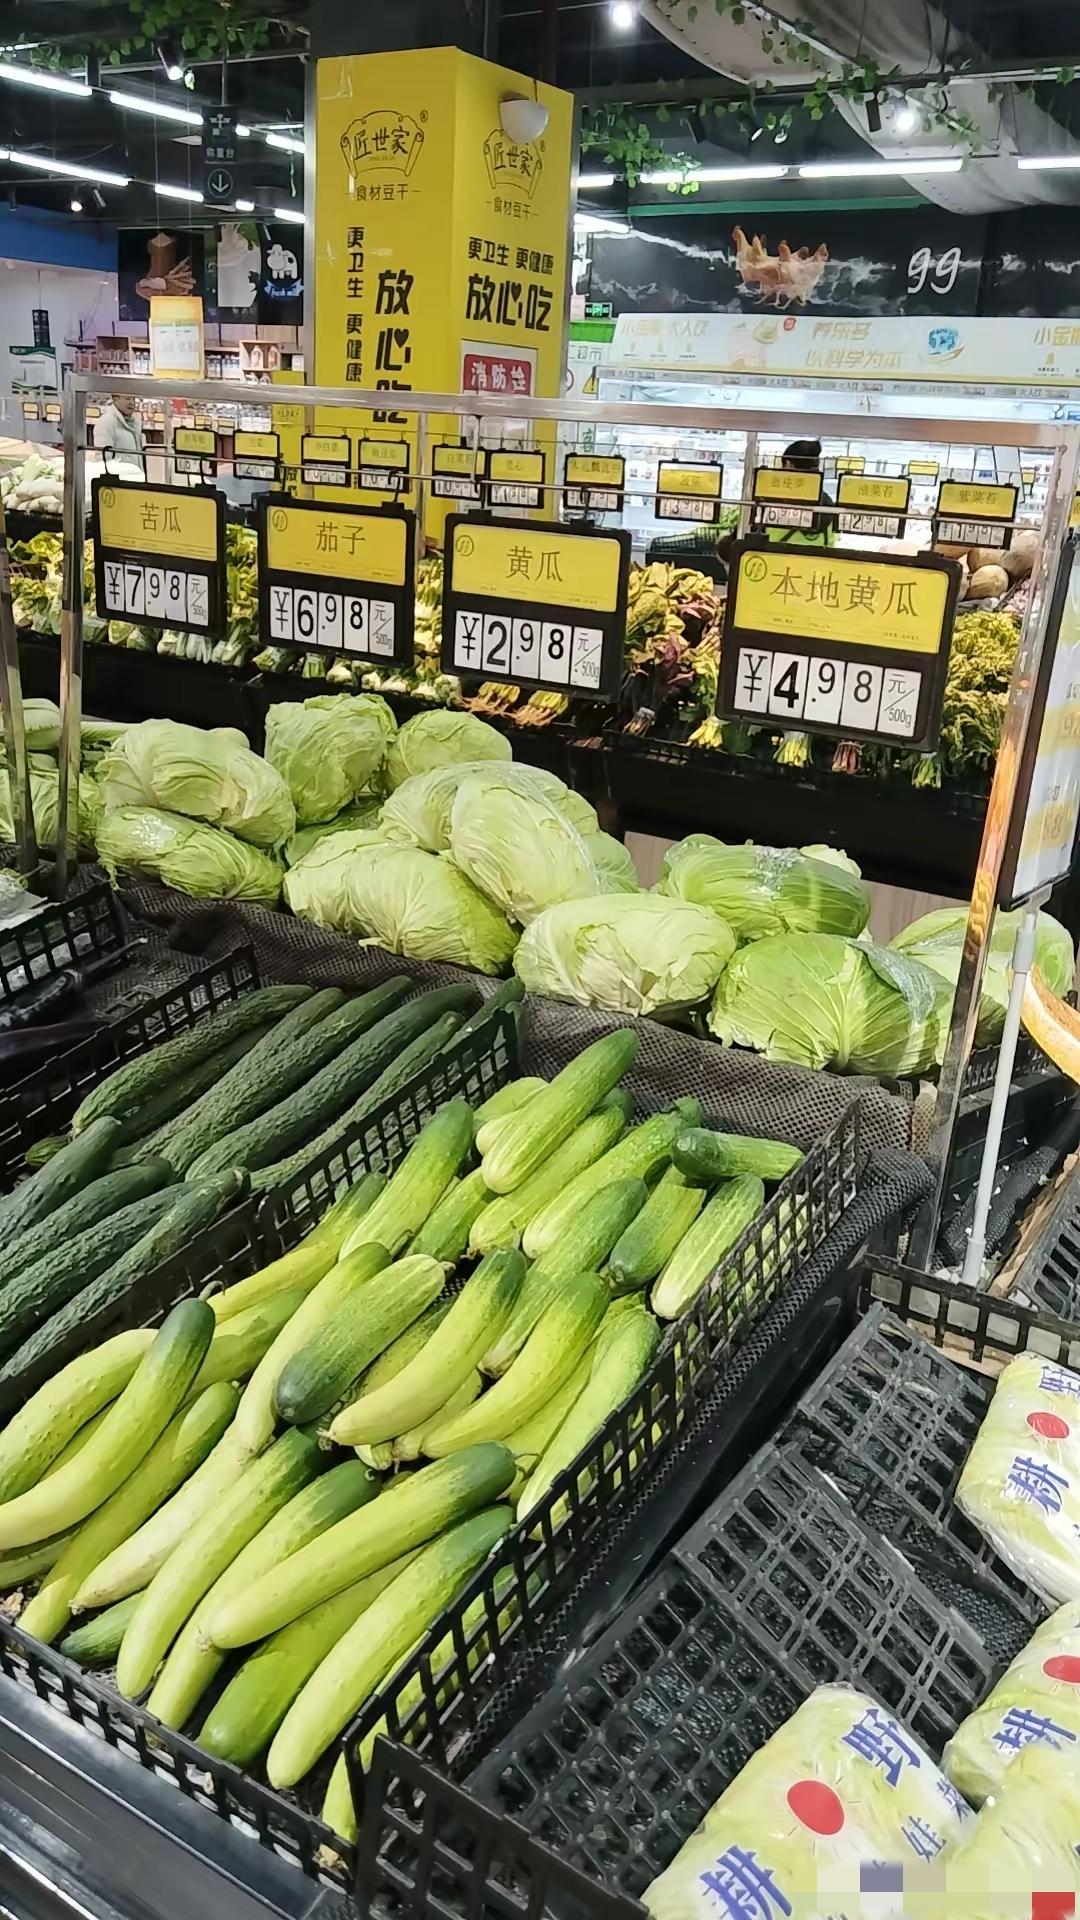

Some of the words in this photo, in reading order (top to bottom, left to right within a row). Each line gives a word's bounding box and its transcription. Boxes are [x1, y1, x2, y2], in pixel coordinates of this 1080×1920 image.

[353, 126, 410, 160] 匠世家
[356, 183, 409, 201] 食材豆干
[347, 227, 364, 298] 更卫生
[469, 236, 510, 267] 更卫生
[516, 247, 554, 275] 更健康
[466, 273, 553, 332] 放心吃
[346, 313, 363, 383] 更健康
[140, 502, 182, 533] 苦瓜
[316, 521, 365, 556] 茄子
[505, 545, 563, 582] 黄瓜
[769, 566, 919, 617] 本地黄瓜
[842, 1708, 921, 1788] 野
[698, 1845, 793, 1920] 耕
